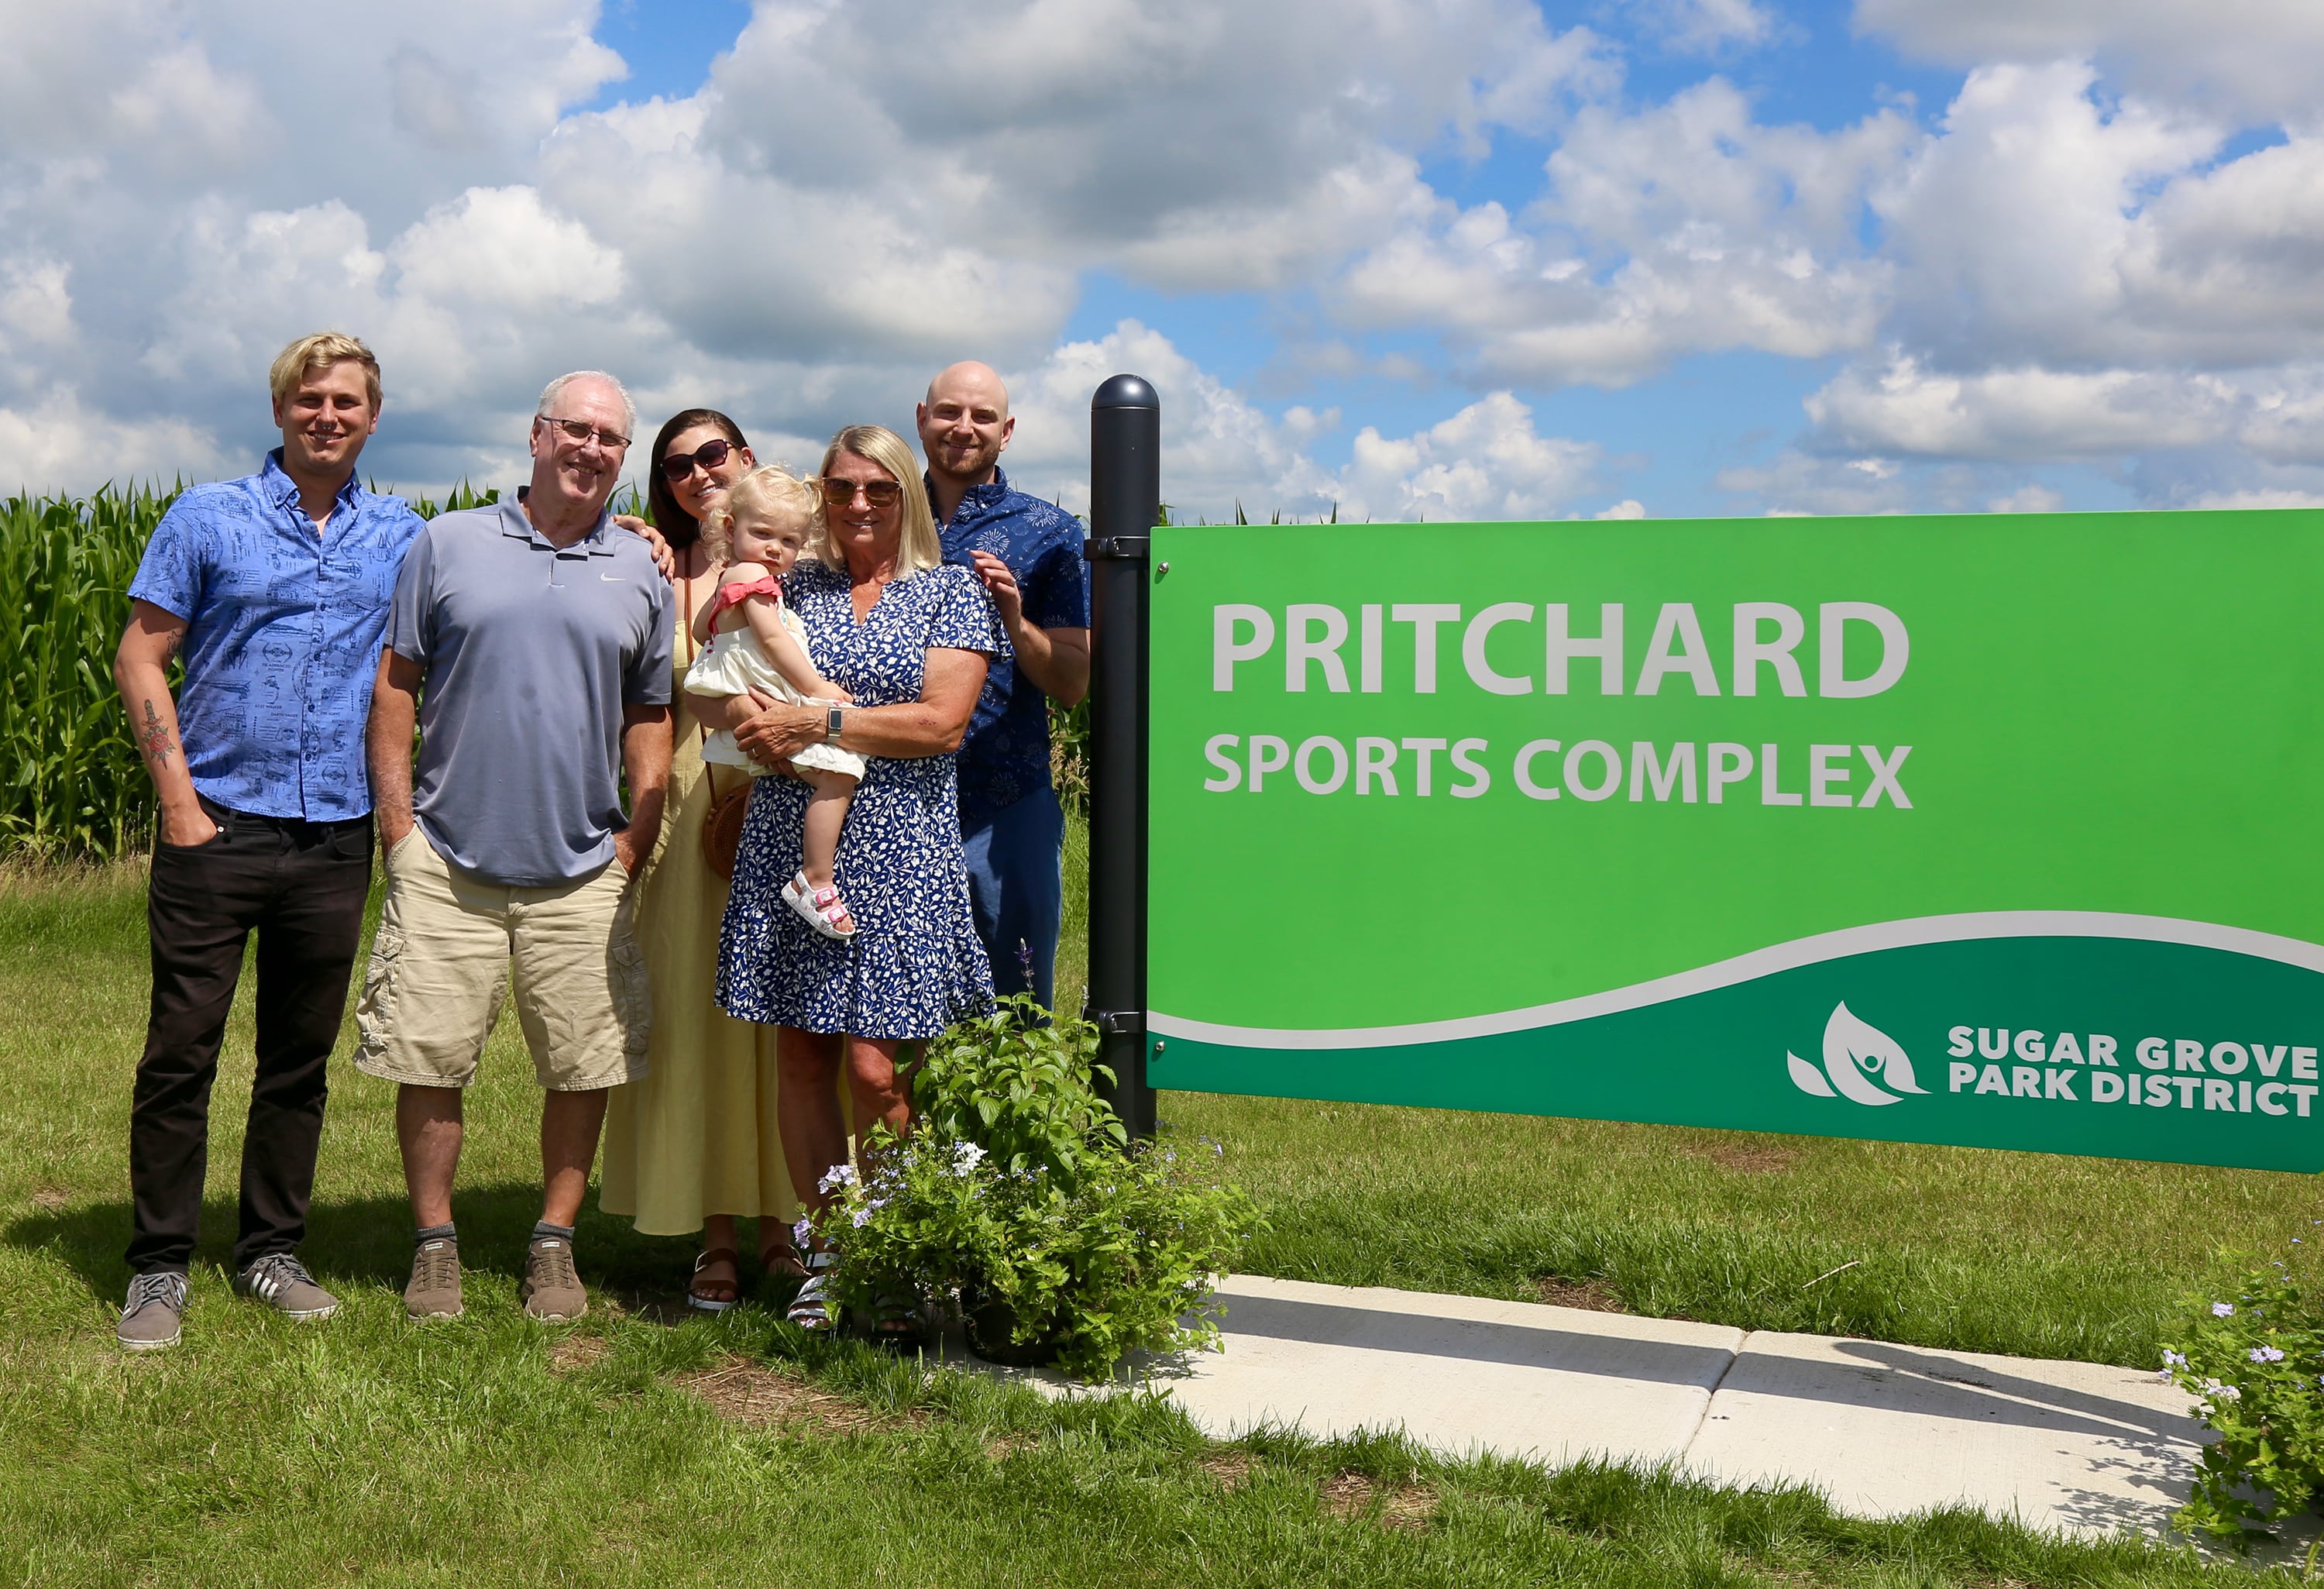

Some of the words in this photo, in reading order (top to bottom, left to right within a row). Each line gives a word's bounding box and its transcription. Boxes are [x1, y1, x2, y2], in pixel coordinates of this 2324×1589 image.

[1213, 601, 1910, 698] PRITCHARD
[1203, 734, 1491, 798] SPORTS
[1513, 738, 1914, 809] COMPLEX
[1947, 1025, 2119, 1067] SUGAR
[2136, 1037, 2319, 1080] GROVE
[1949, 1062, 2078, 1101] PARK
[2092, 1071, 2319, 1117] DISTRICT
